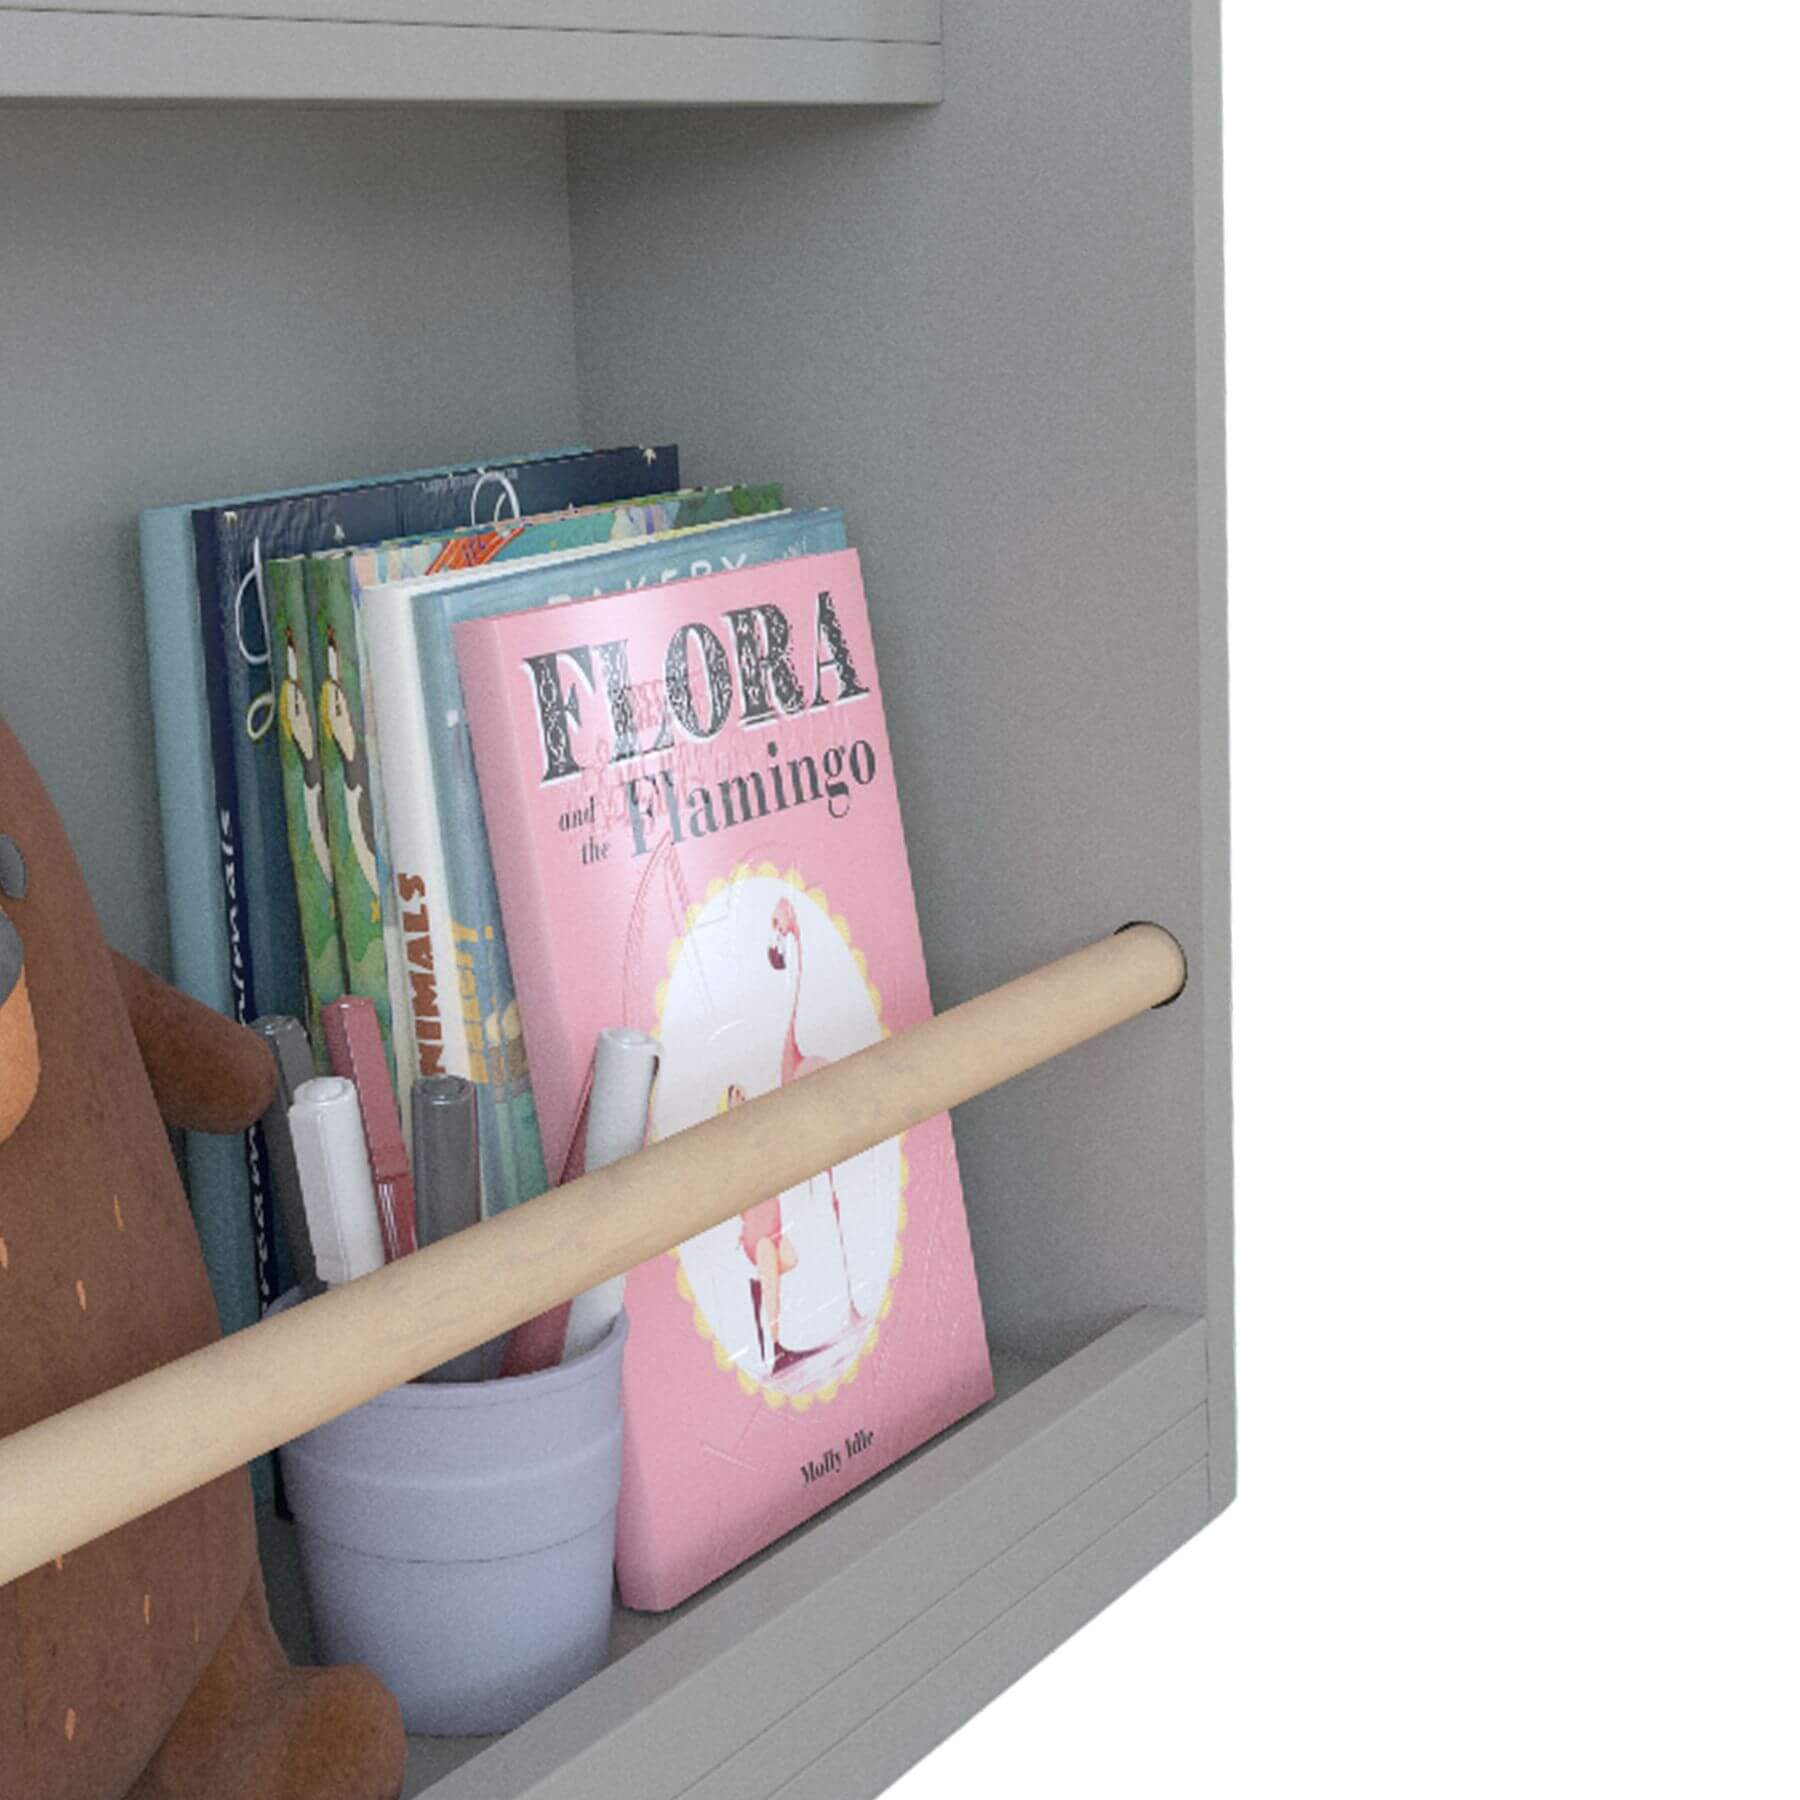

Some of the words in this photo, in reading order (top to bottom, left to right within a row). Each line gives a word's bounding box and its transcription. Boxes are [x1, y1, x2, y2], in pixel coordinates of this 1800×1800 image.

[522, 591, 870, 786] FLORA
[559, 796, 595, 832] and
[623, 739, 876, 858] Flamingo
[581, 836, 610, 865] the
[397, 872, 447, 1077] NIMALS
[800, 1448, 842, 1484] Molly
